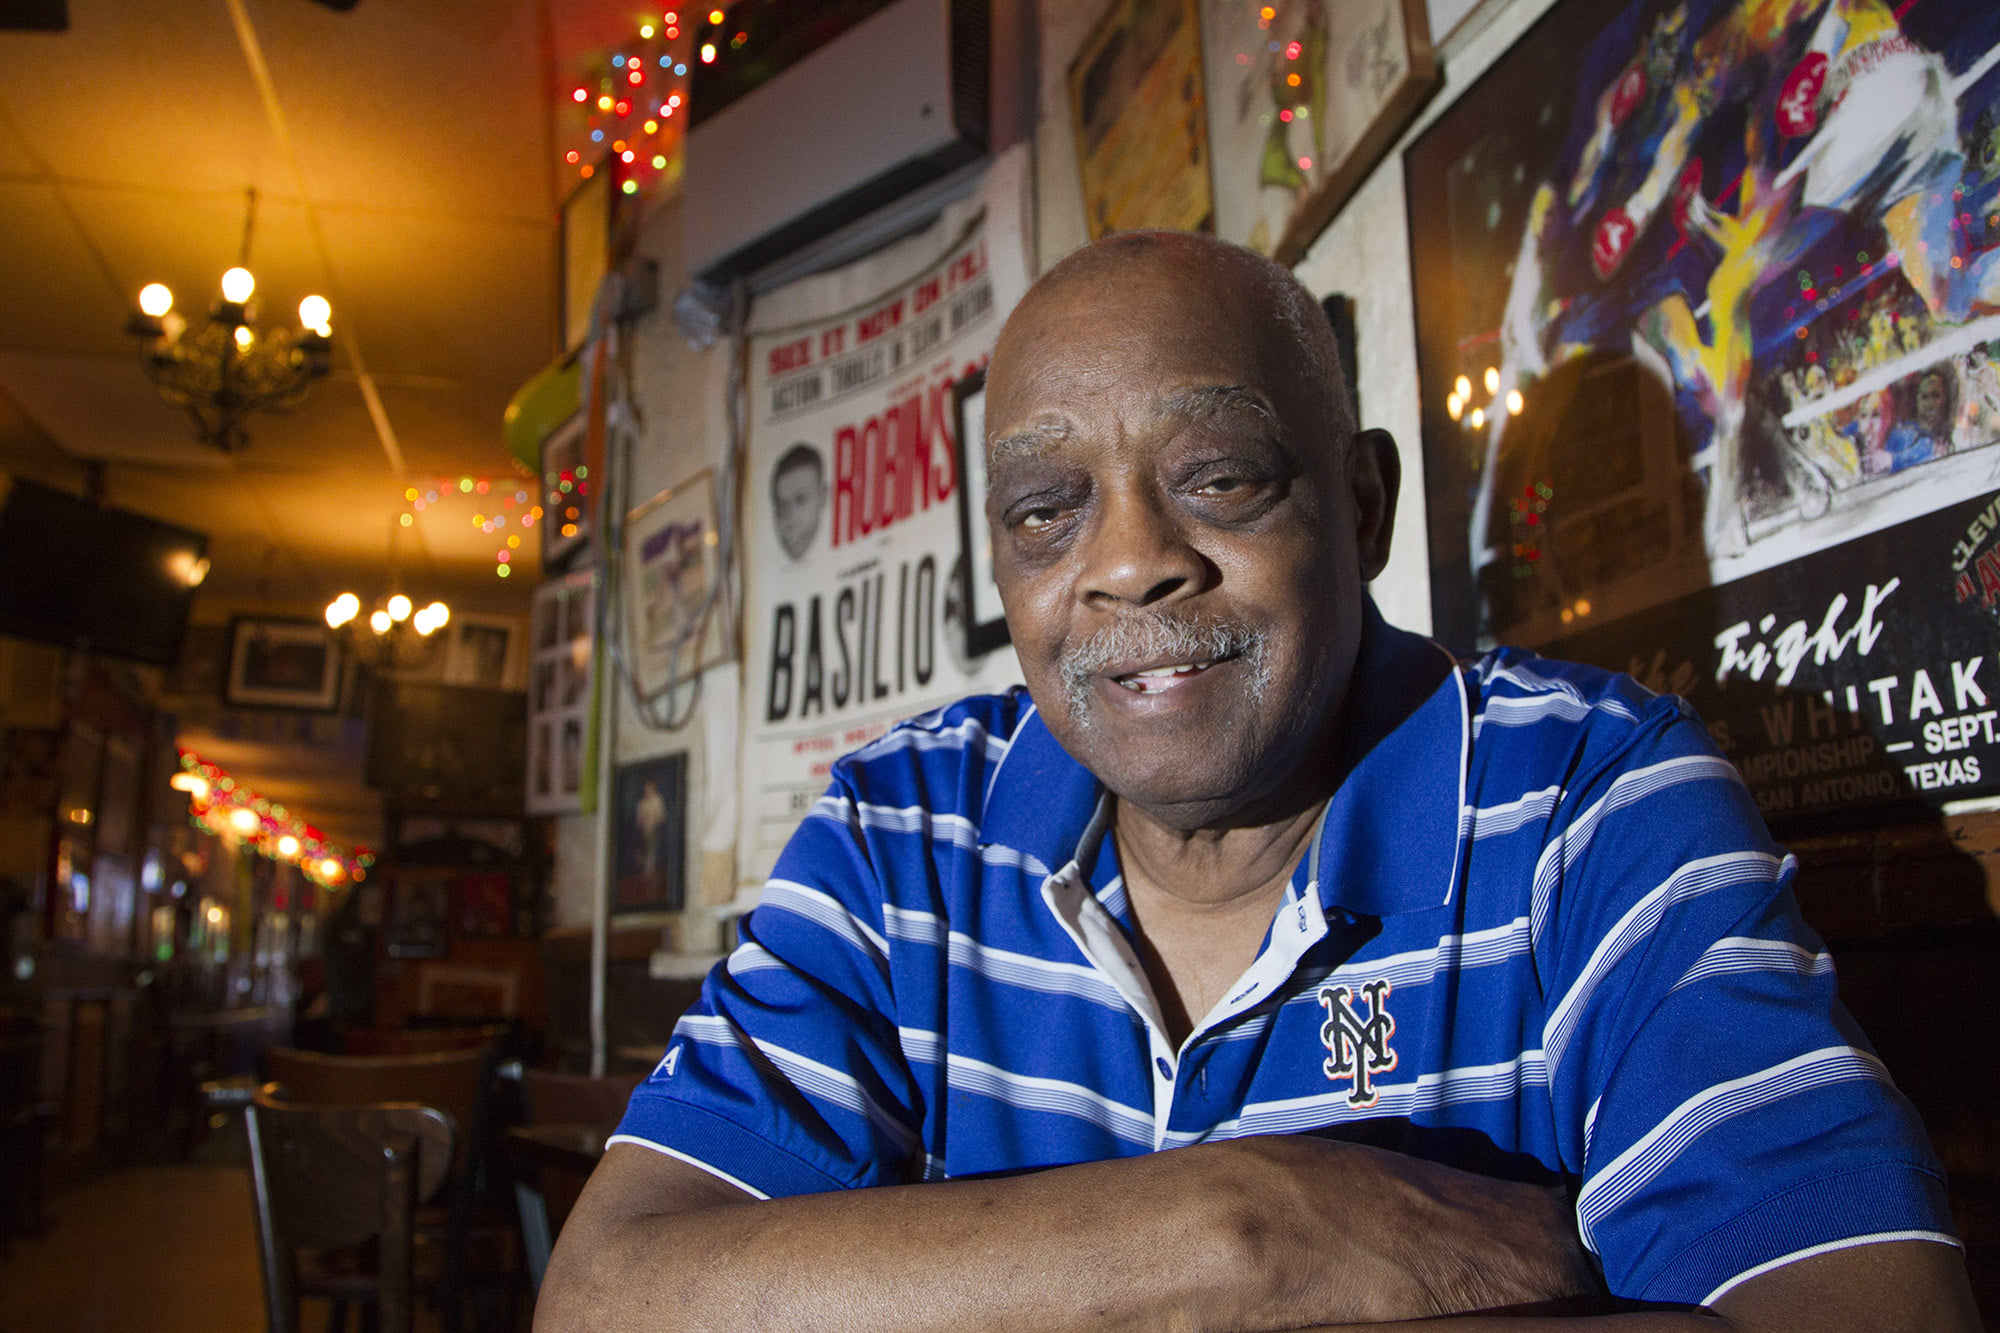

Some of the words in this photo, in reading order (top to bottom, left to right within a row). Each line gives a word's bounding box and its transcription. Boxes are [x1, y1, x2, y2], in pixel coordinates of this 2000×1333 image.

[769, 336, 812, 375] SEE
[821, 325, 846, 358] IT
[857, 299, 903, 343] NOW
[914, 276, 940, 314] ON
[766, 554, 937, 722] BASILIO
[1713, 576, 1900, 692] Fight
[1904, 756, 1981, 790] TEXAS
